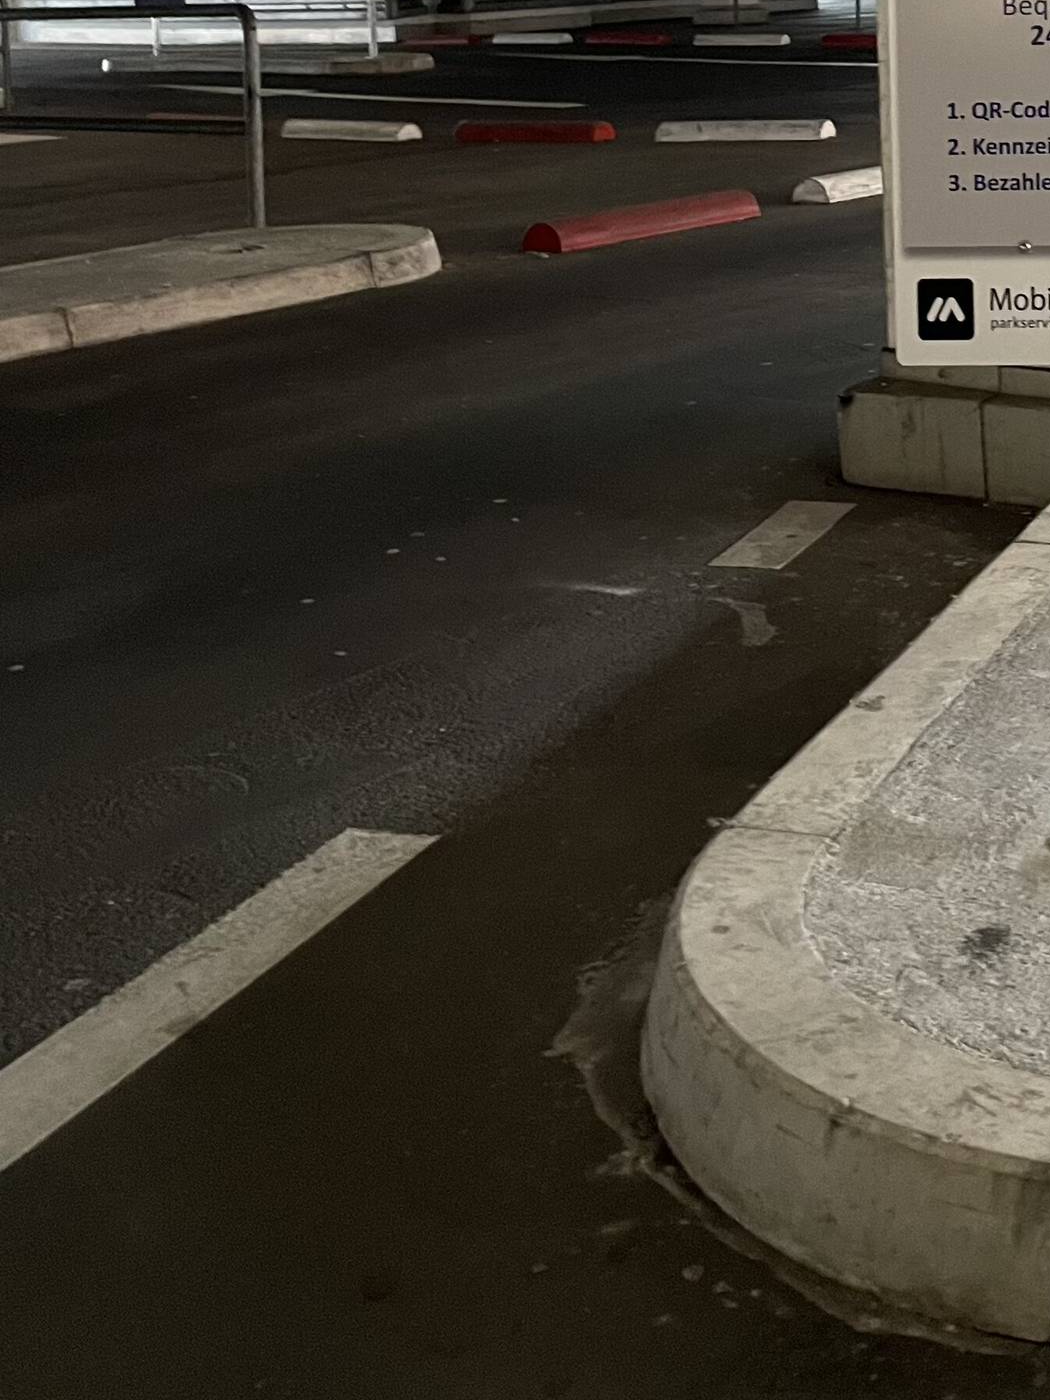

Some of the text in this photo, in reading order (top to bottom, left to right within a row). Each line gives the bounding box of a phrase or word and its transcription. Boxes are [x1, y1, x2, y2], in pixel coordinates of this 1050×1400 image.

[947, 102, 966, 120] 1.
[947, 138, 966, 156] 2.
[948, 174, 967, 192] 3.
